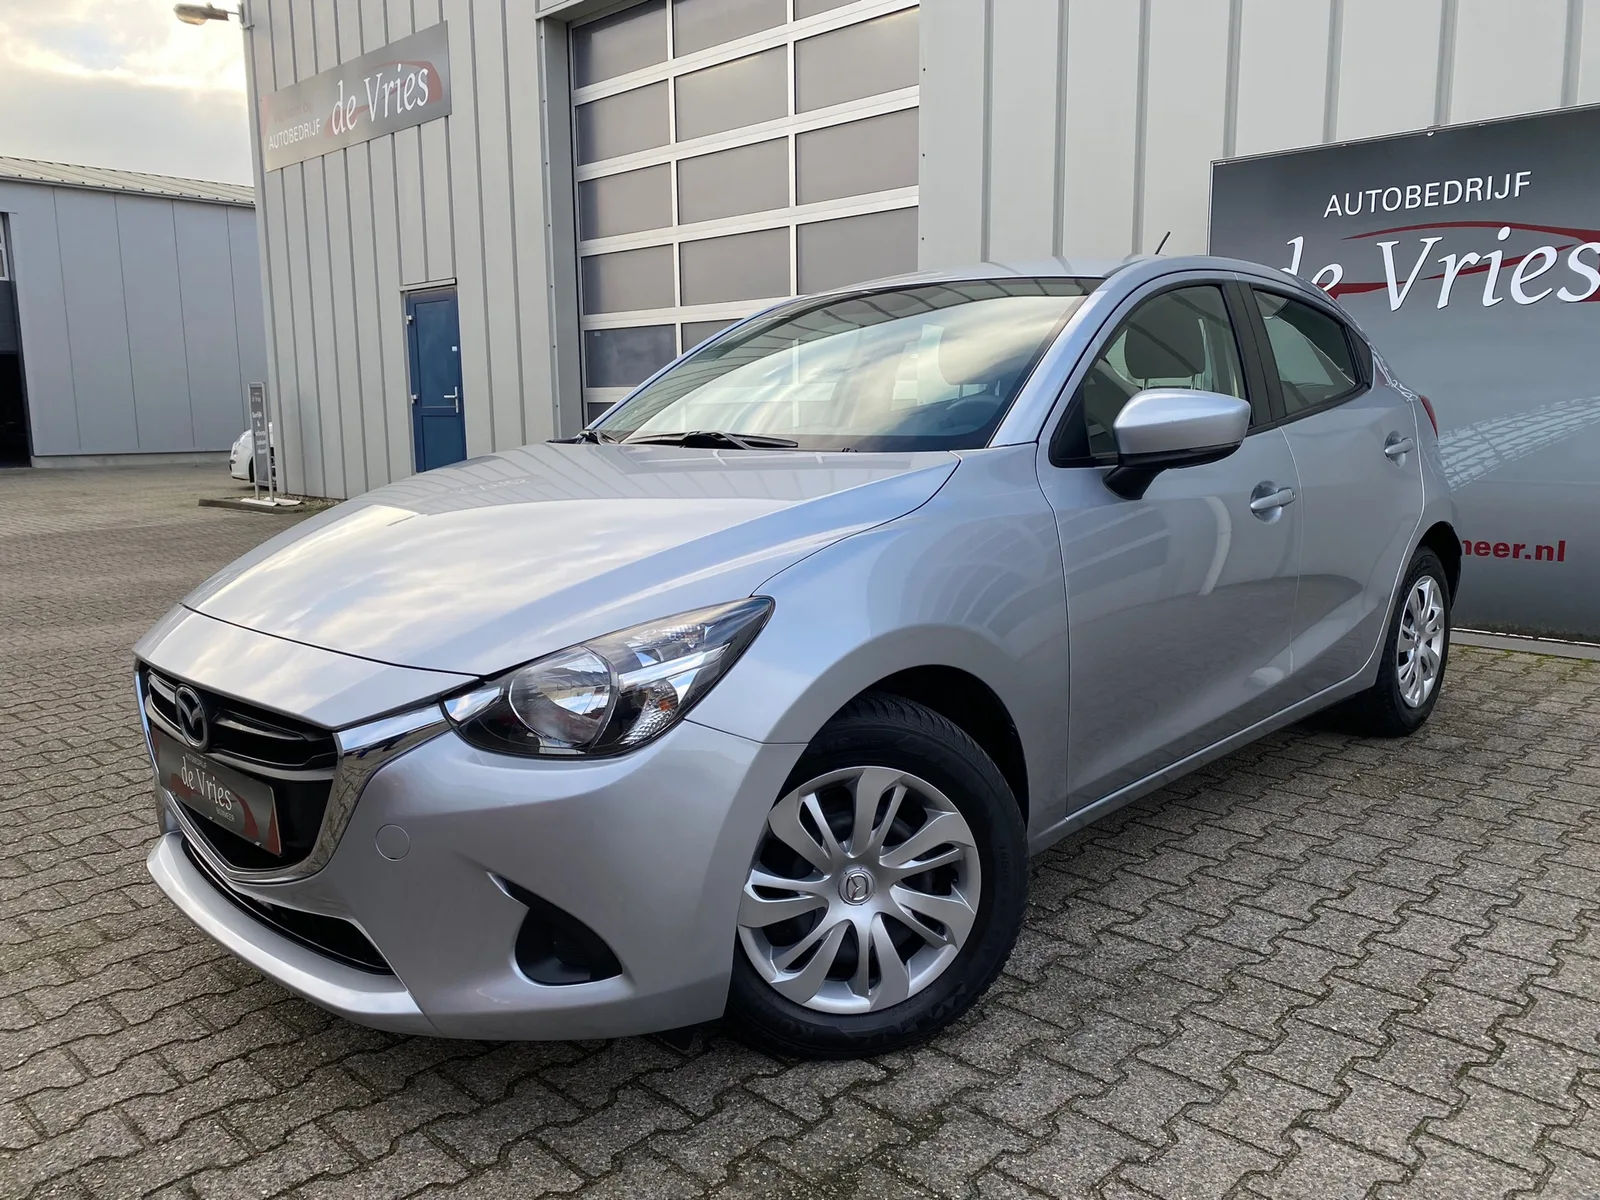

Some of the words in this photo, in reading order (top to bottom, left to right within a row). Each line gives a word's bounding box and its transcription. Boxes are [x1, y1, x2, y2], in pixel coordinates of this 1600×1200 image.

[268, 118, 321, 150] AUTOBEDRIJF
[331, 79, 358, 136] de
[363, 63, 429, 122] Vries
[1323, 171, 1532, 218] AUTOBEDRIJF
[1376, 226, 1600, 312] Vries
[181, 756, 195, 790] de
[196, 768, 232, 811] Vries
